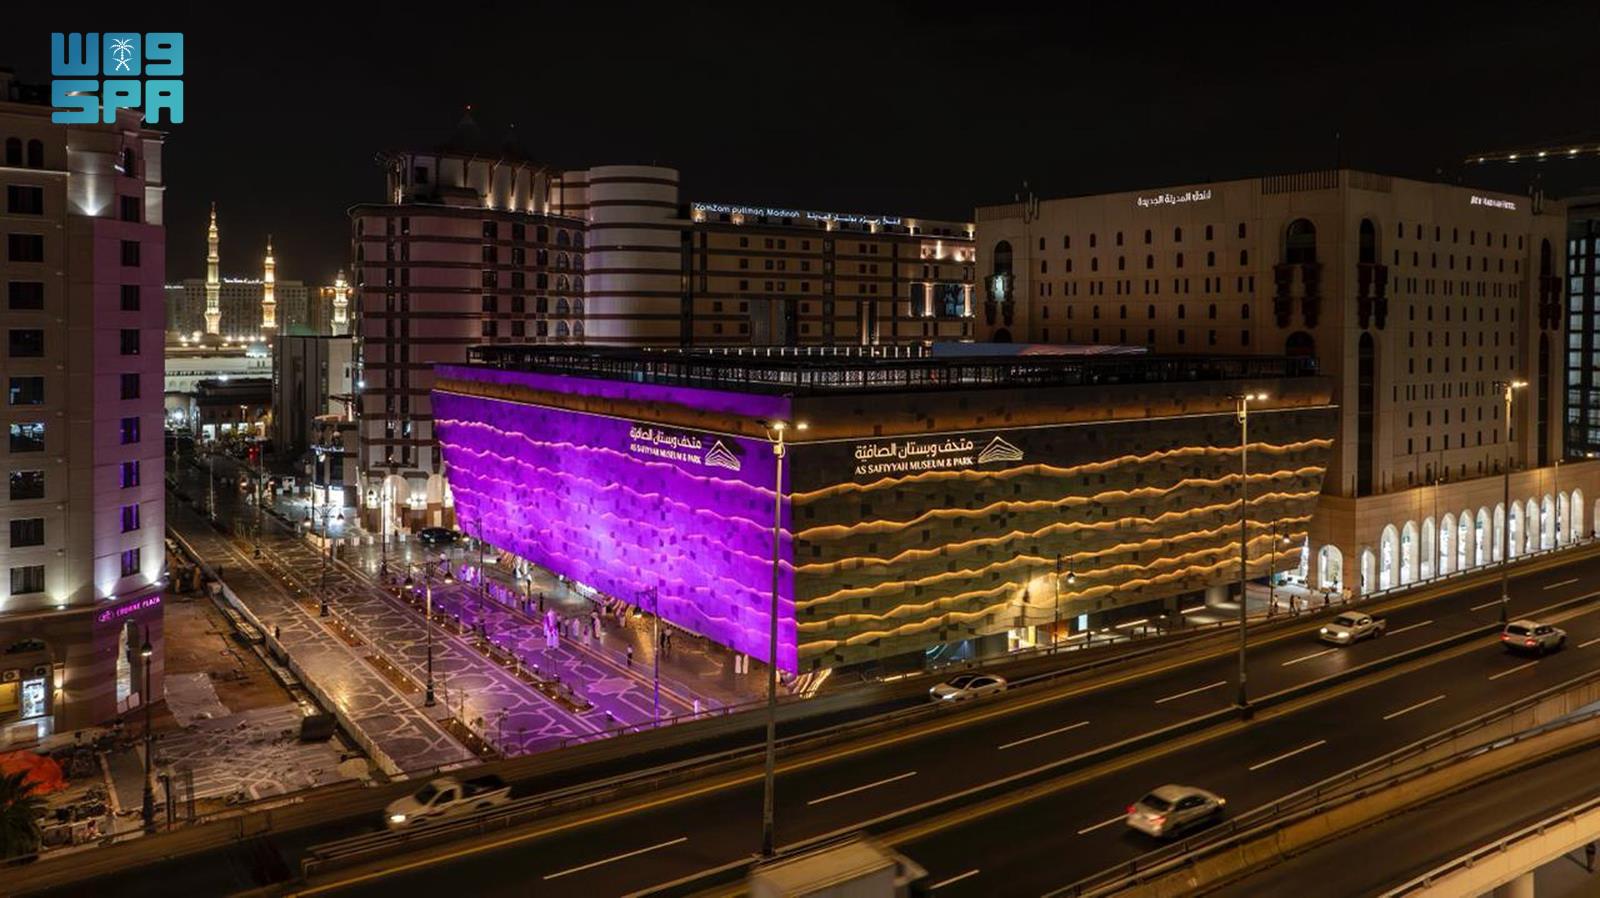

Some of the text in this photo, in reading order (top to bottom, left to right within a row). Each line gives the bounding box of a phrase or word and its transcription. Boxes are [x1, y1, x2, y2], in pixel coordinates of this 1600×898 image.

[678, 436, 702, 449] متحف
[898, 441, 938, 459] وبستان
[938, 437, 974, 453] متحف
[660, 450, 682, 461] MUSEUM
[687, 454, 702, 464] PARK
[855, 456, 974, 475] AS SAFIYYAH MUSEUM & PARK
[142, 597, 160, 608] PLAZA
